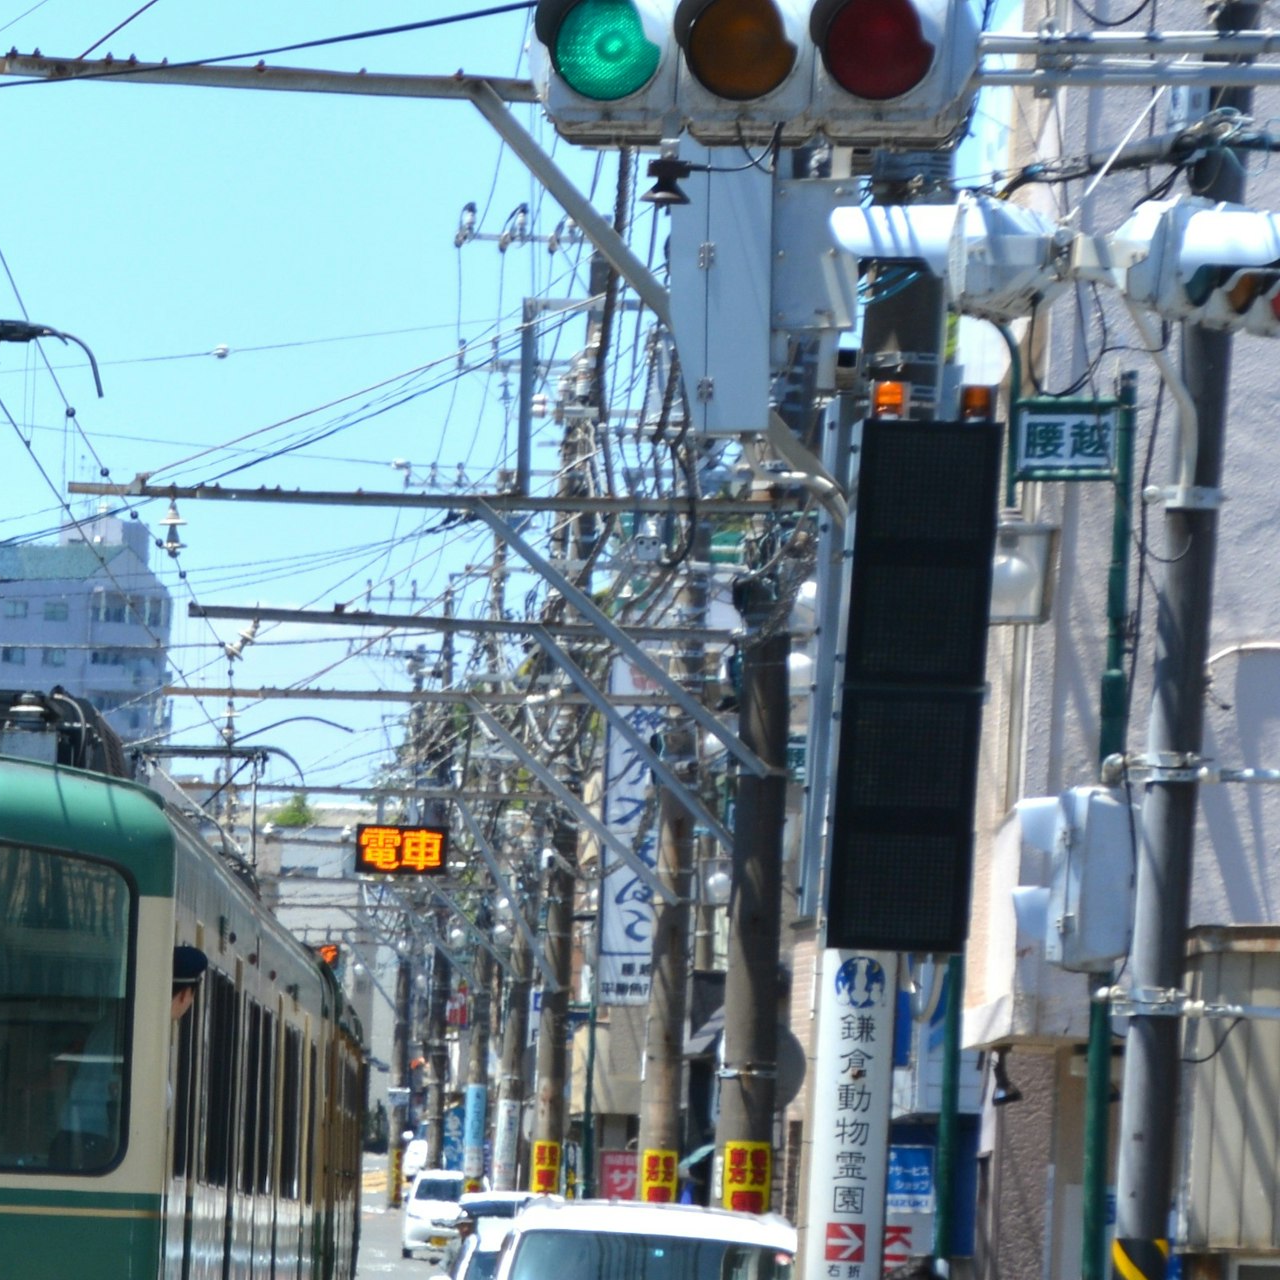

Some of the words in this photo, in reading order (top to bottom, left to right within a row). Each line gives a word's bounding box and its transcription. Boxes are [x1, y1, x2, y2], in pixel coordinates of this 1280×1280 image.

[1024, 420, 1111, 459] 腰越
[360, 827, 443, 870] 電車
[833, 1013, 877, 1214] 鎌倉動物霊園
[827, 1264, 861, 1279] 右折
